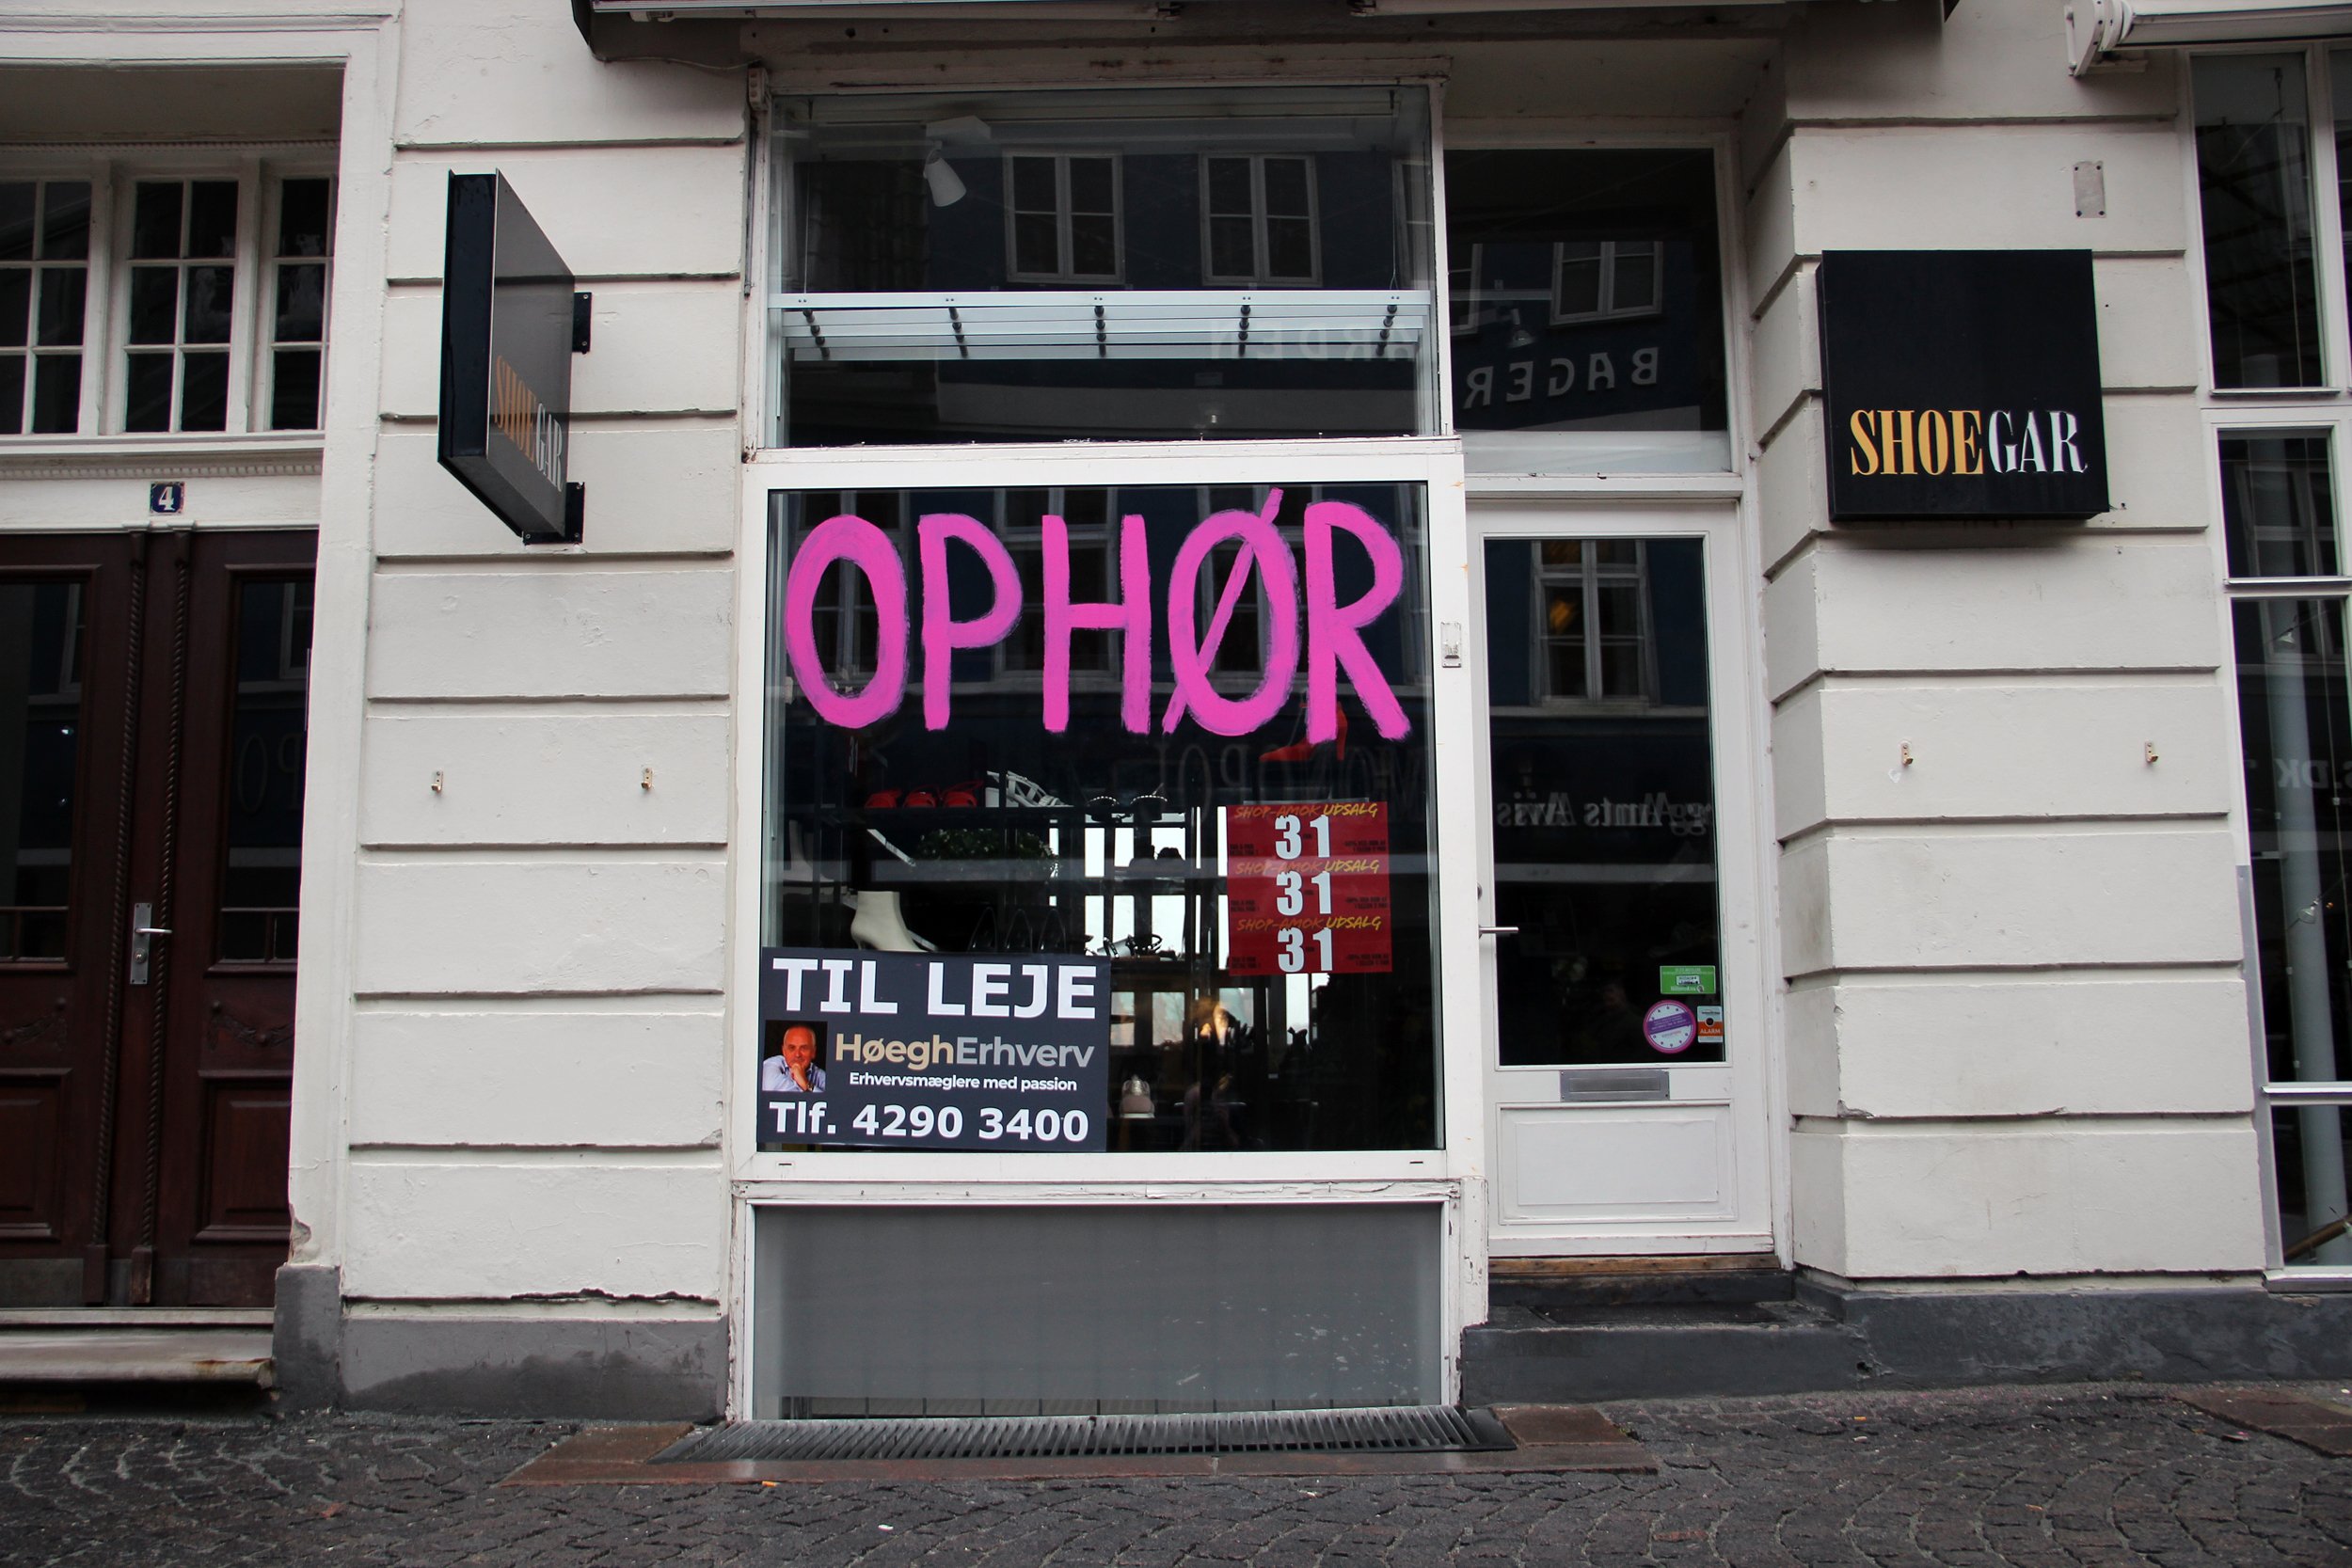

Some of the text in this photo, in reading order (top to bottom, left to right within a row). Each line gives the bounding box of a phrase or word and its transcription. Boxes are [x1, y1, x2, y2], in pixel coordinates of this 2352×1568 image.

[494, 355, 563, 493] SHOEGAR
[1850, 409, 2089, 475] SHOEGAR
[158, 485, 176, 511] 4
[785, 487, 1411, 744] OPHØR
[1322, 802, 1378, 817] UDSALG
[1324, 860, 1380, 874] UDSALG
[1326, 916, 1381, 930] UDSALG
[772, 958, 1096, 1019] TIL LEJE
[834, 1033, 1094, 1070] HøeghErhverv
[850, 1072, 1077, 1092] Erhvervsmæglere med passion
[769, 1101, 1089, 1142] Tlf. 4290 3400
